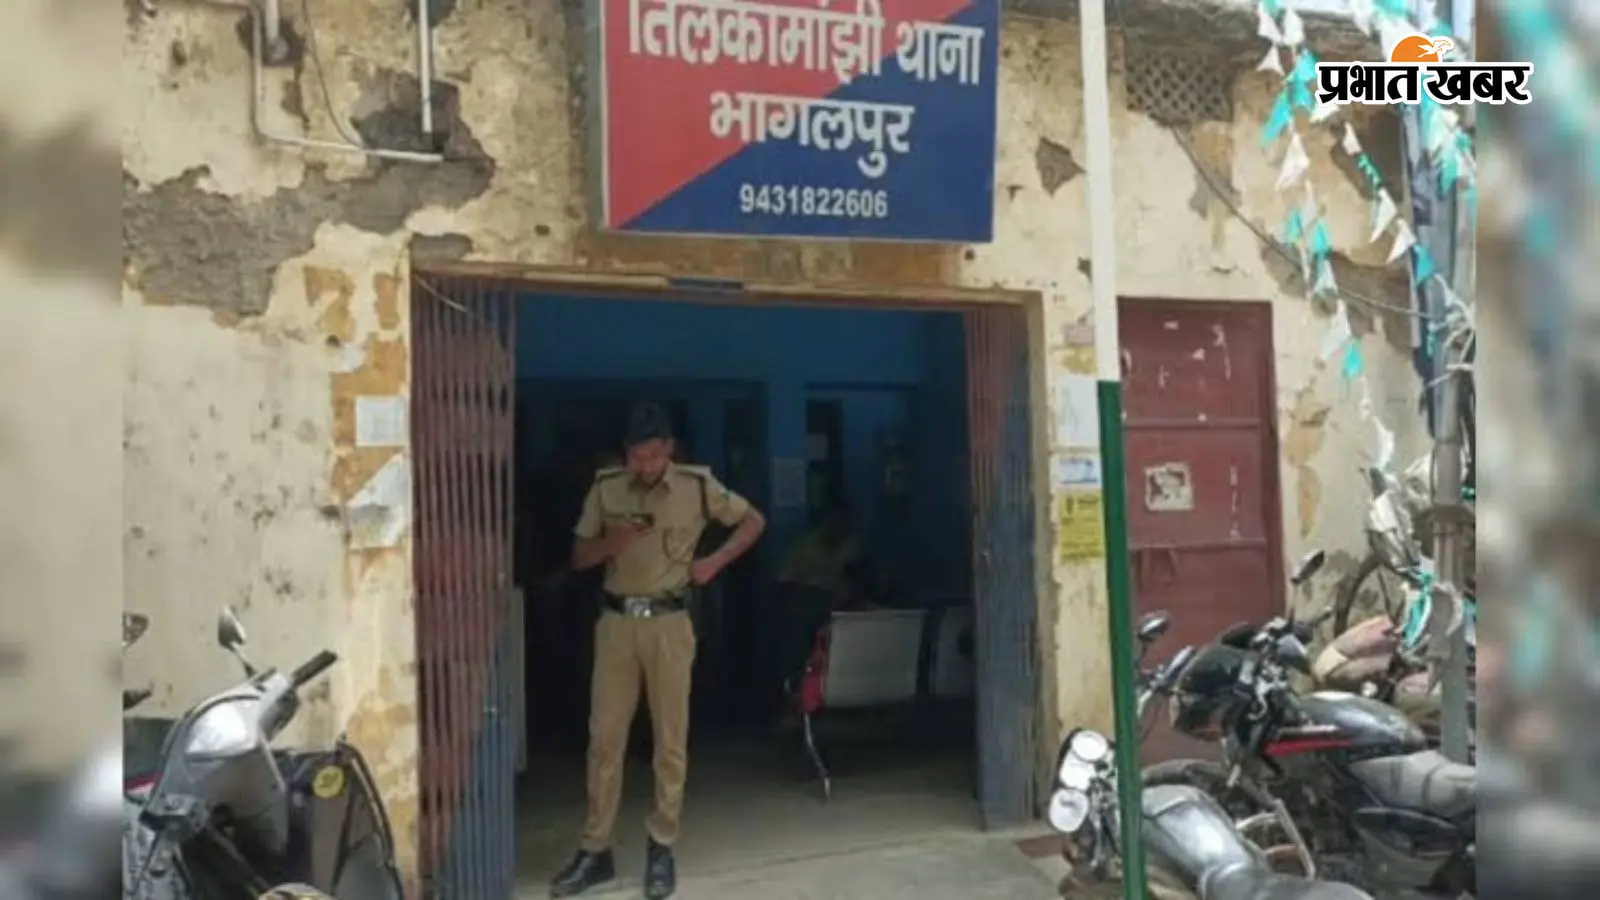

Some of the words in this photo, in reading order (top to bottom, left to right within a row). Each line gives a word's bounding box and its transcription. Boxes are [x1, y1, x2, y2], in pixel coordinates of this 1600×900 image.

[896, 20, 984, 84] थाना
[709, 91, 914, 178] भागलपुर
[740, 183, 888, 218] 9431822606
